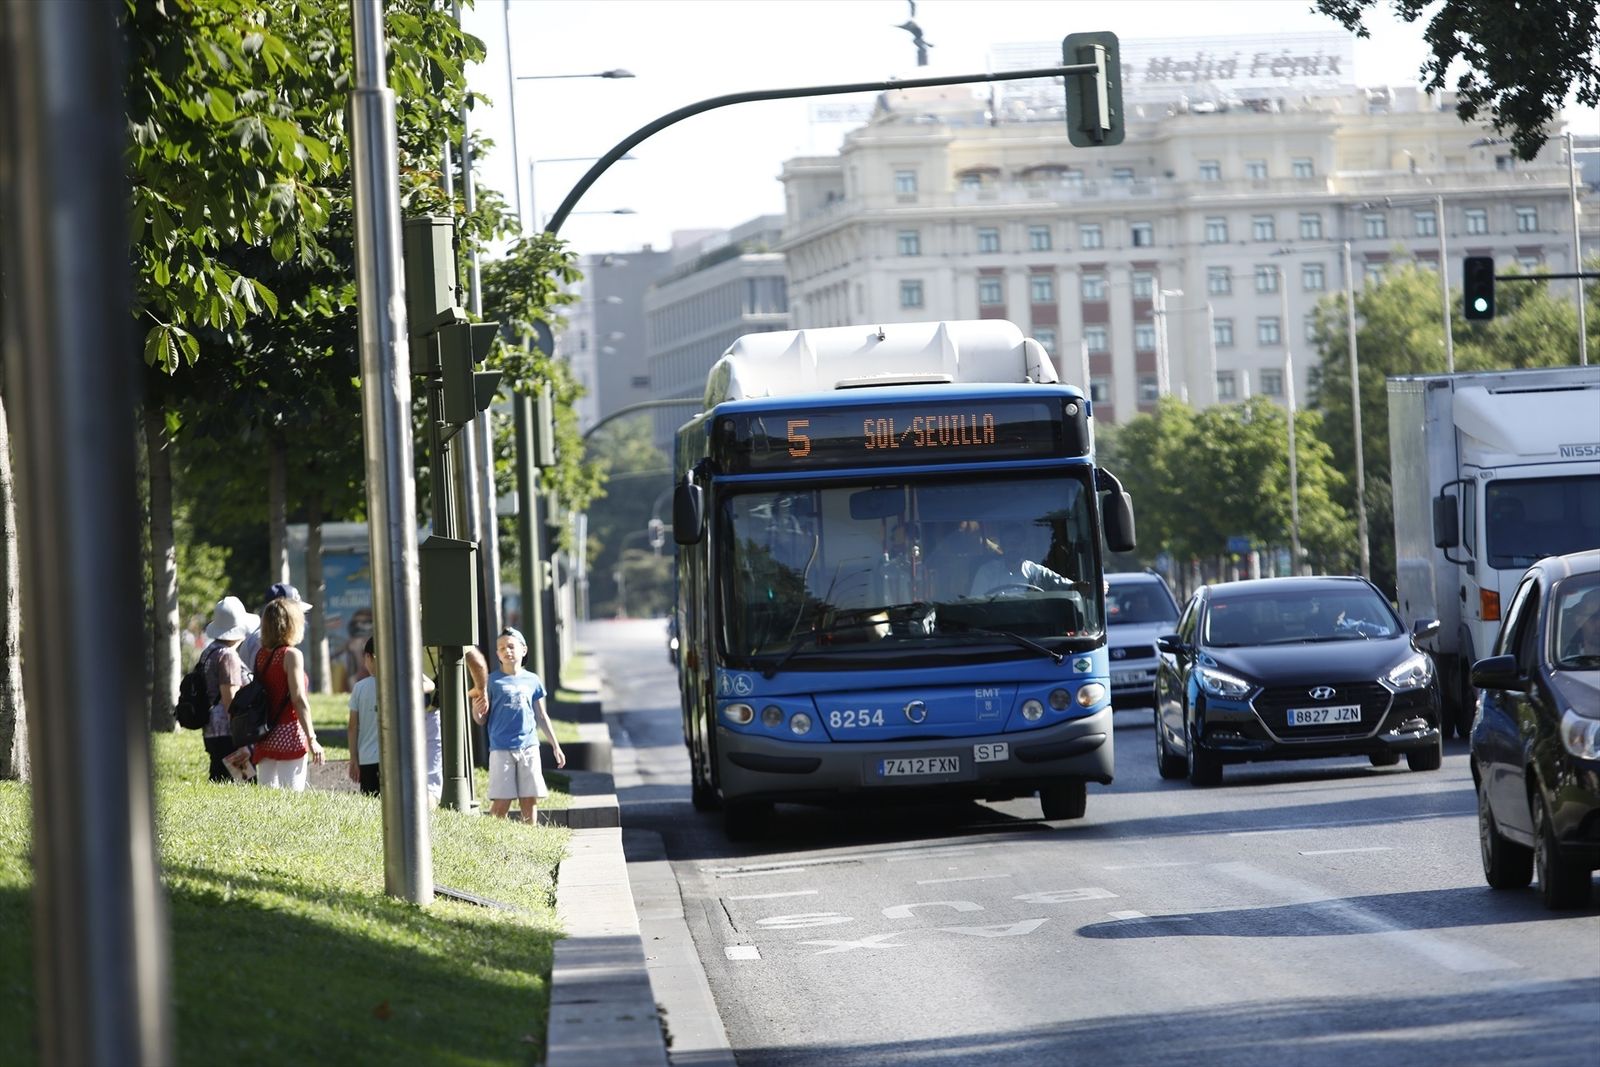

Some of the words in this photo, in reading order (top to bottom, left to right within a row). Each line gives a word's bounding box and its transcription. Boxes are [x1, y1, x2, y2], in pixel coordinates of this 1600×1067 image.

[786, 419, 812, 458] 5
[975, 688, 1000, 698] EMT
[829, 709, 885, 729] 8254
[1296, 709, 1329, 723] 8827
[1334, 707, 1358, 721] JZN
[978, 745, 1006, 760] SP
